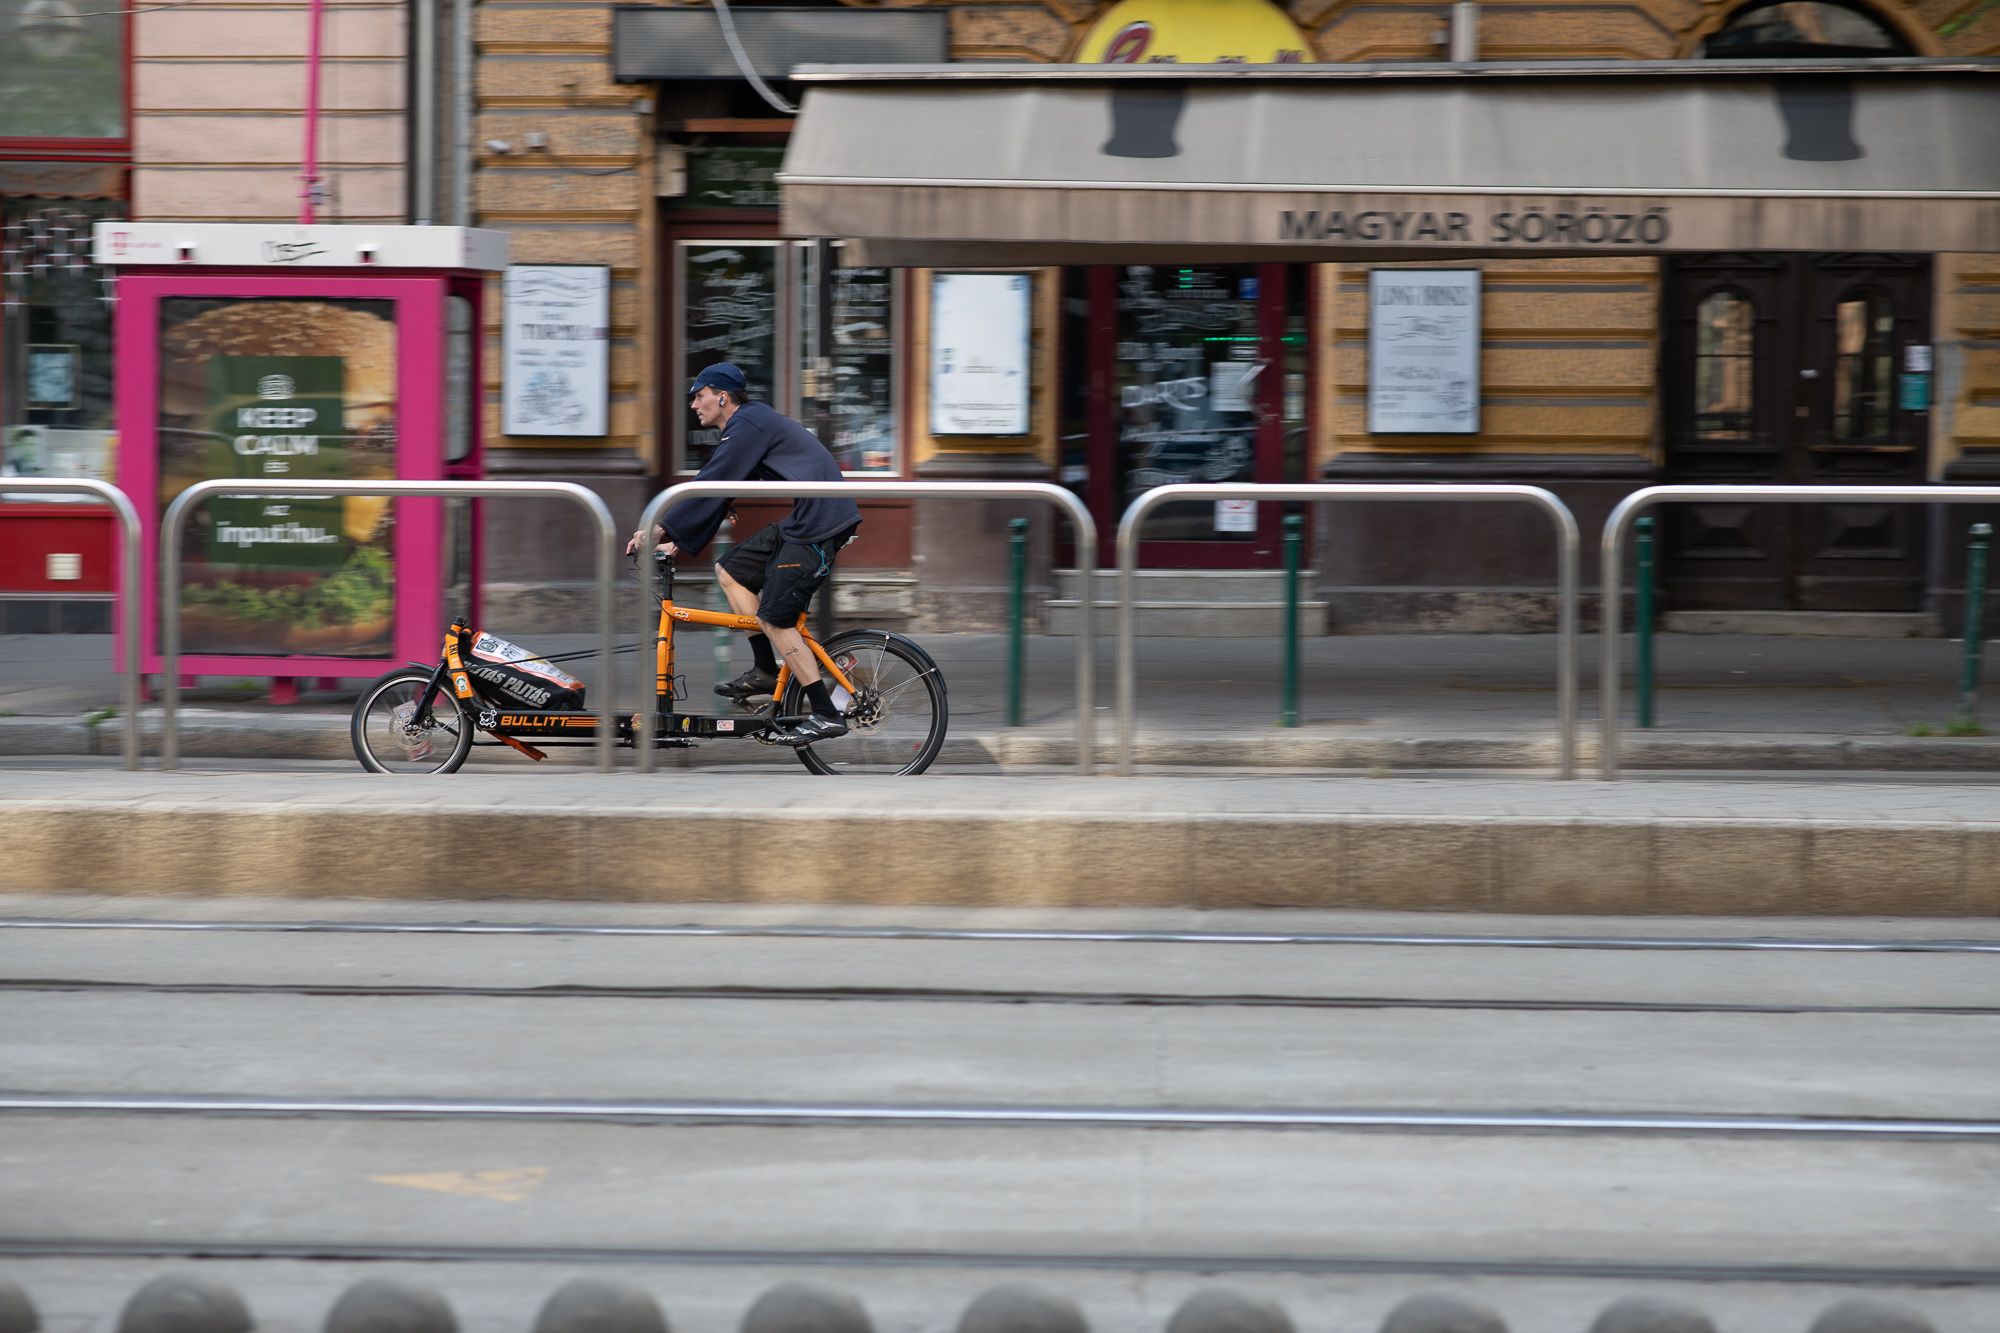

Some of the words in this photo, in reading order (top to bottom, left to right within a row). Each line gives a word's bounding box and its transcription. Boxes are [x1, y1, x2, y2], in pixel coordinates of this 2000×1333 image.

[1278, 209, 1471, 242] MAGYAR
[1491, 205, 1673, 245] SÖRÖZŐ
[237, 407, 318, 428] KEEP
[234, 434, 319, 456] CALM
[502, 676, 552, 705] PAJTÁS
[500, 715, 570, 727] BULLITT
